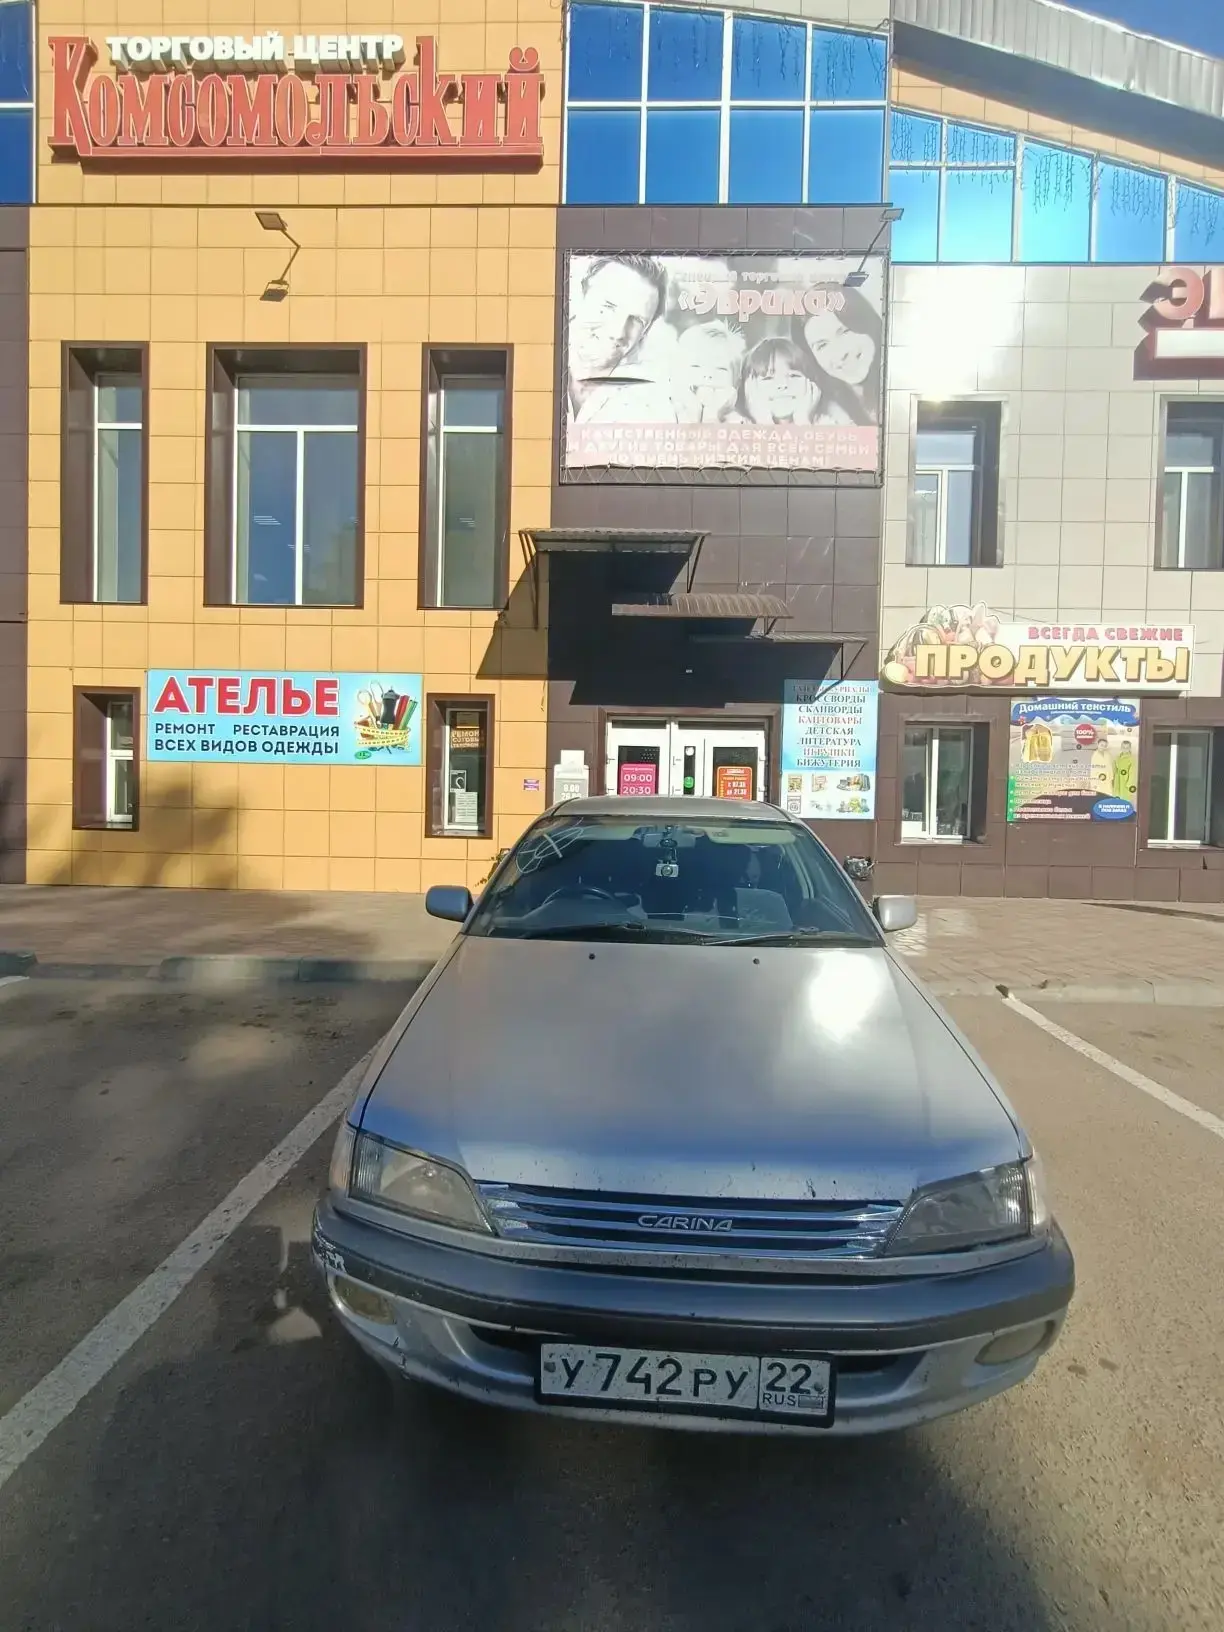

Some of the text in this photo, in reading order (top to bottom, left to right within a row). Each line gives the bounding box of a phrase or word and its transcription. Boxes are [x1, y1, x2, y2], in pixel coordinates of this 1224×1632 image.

[106, 30, 404, 65] ТОРГОВЫЙ ЦЕНТР
[1027, 626, 1184, 642] ВСЕГДА СВЕЖИЕ
[914, 643, 1190, 687] ПРОДУКТЫ
[153, 675, 340, 717] АТЕЛЬЕ
[1019, 702, 1131, 713] Домашний текстиль
[155, 722, 340, 738] РЕМОНТ РЕСТАВРАЦИЯ
[805, 726, 854, 735] ДЕТСКАЯ
[154, 738, 339, 755] ВСЕХ ВИДОВ ОДЕЖДЫ
[637, 1215, 733, 1232] CARINA
[765, 1361, 812, 1395] 22
[763, 1392, 797, 1407] RUS
